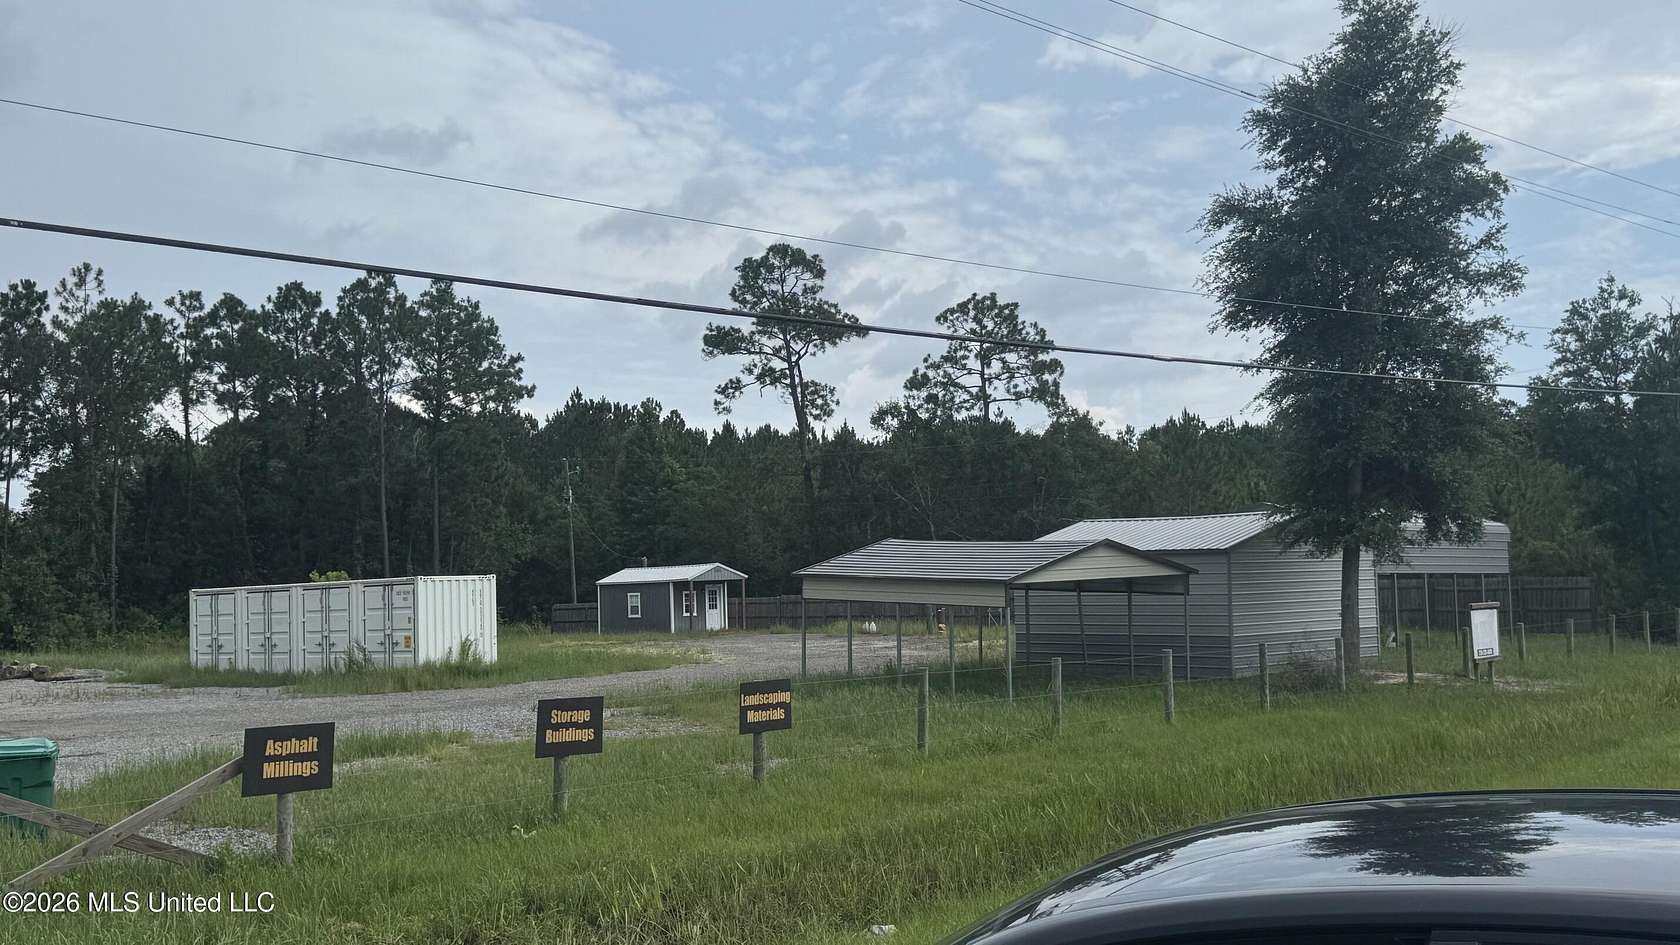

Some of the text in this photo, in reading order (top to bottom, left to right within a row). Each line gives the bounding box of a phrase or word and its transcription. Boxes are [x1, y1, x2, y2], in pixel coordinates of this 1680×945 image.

[741, 690, 791, 707] Landscaping
[551, 709, 591, 724] Storage
[747, 707, 785, 723] Materials
[545, 728, 594, 744] Buildings
[265, 736, 319, 756] Asphalt
[263, 760, 319, 779] Millings
